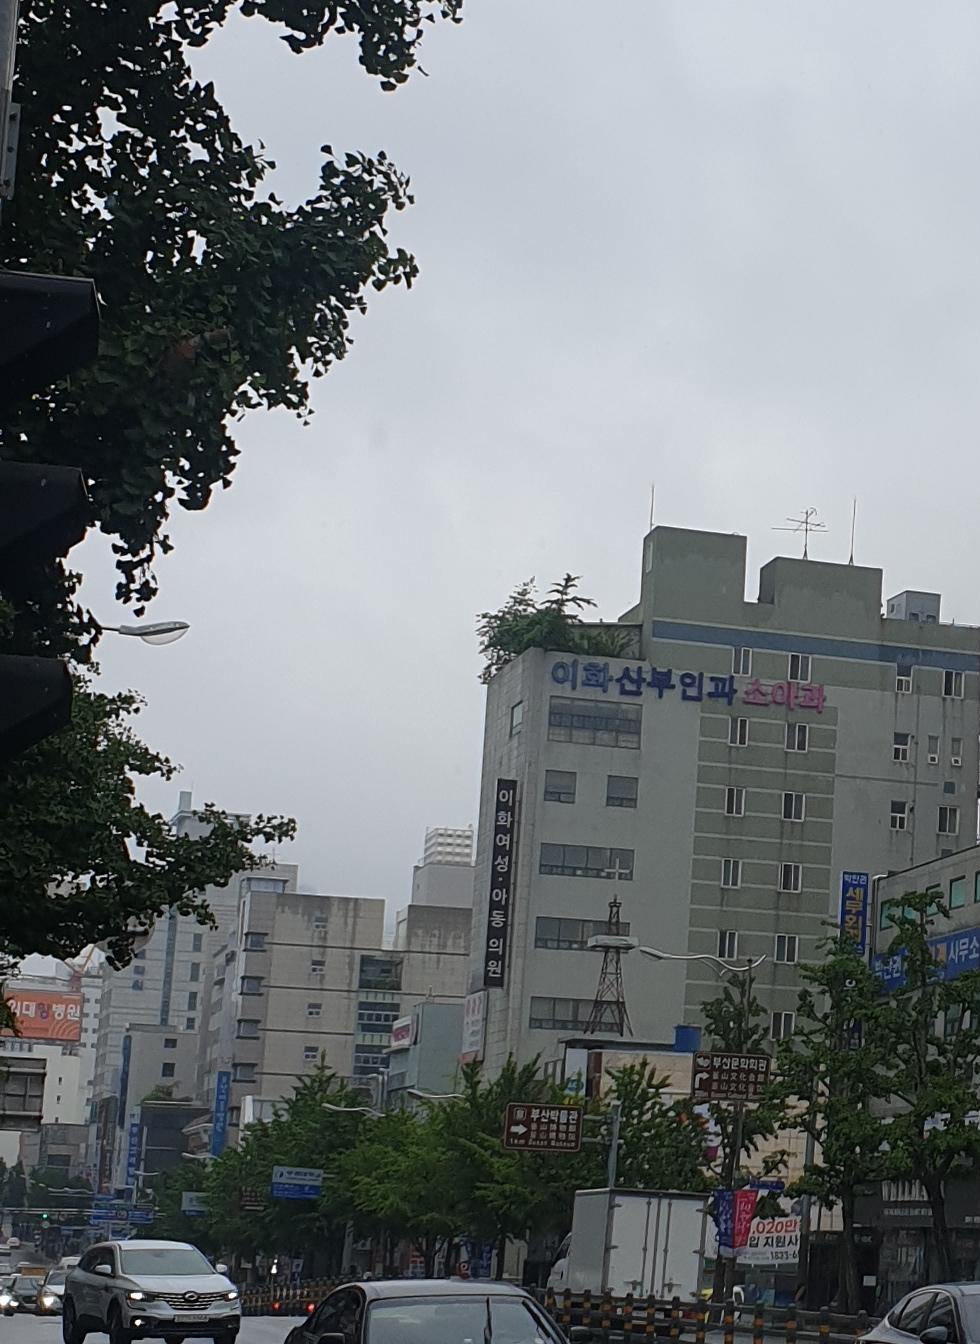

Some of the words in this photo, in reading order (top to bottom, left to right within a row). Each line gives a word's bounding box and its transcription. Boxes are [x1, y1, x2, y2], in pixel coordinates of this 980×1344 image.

[551, 658, 738, 705] 이화산부인과
[743, 678, 826, 713] 소아과
[949, 935, 980, 964] 사무소
[713, 1057, 767, 1072] 부산문화회관
[530, 1108, 578, 1124] 부산박물관
